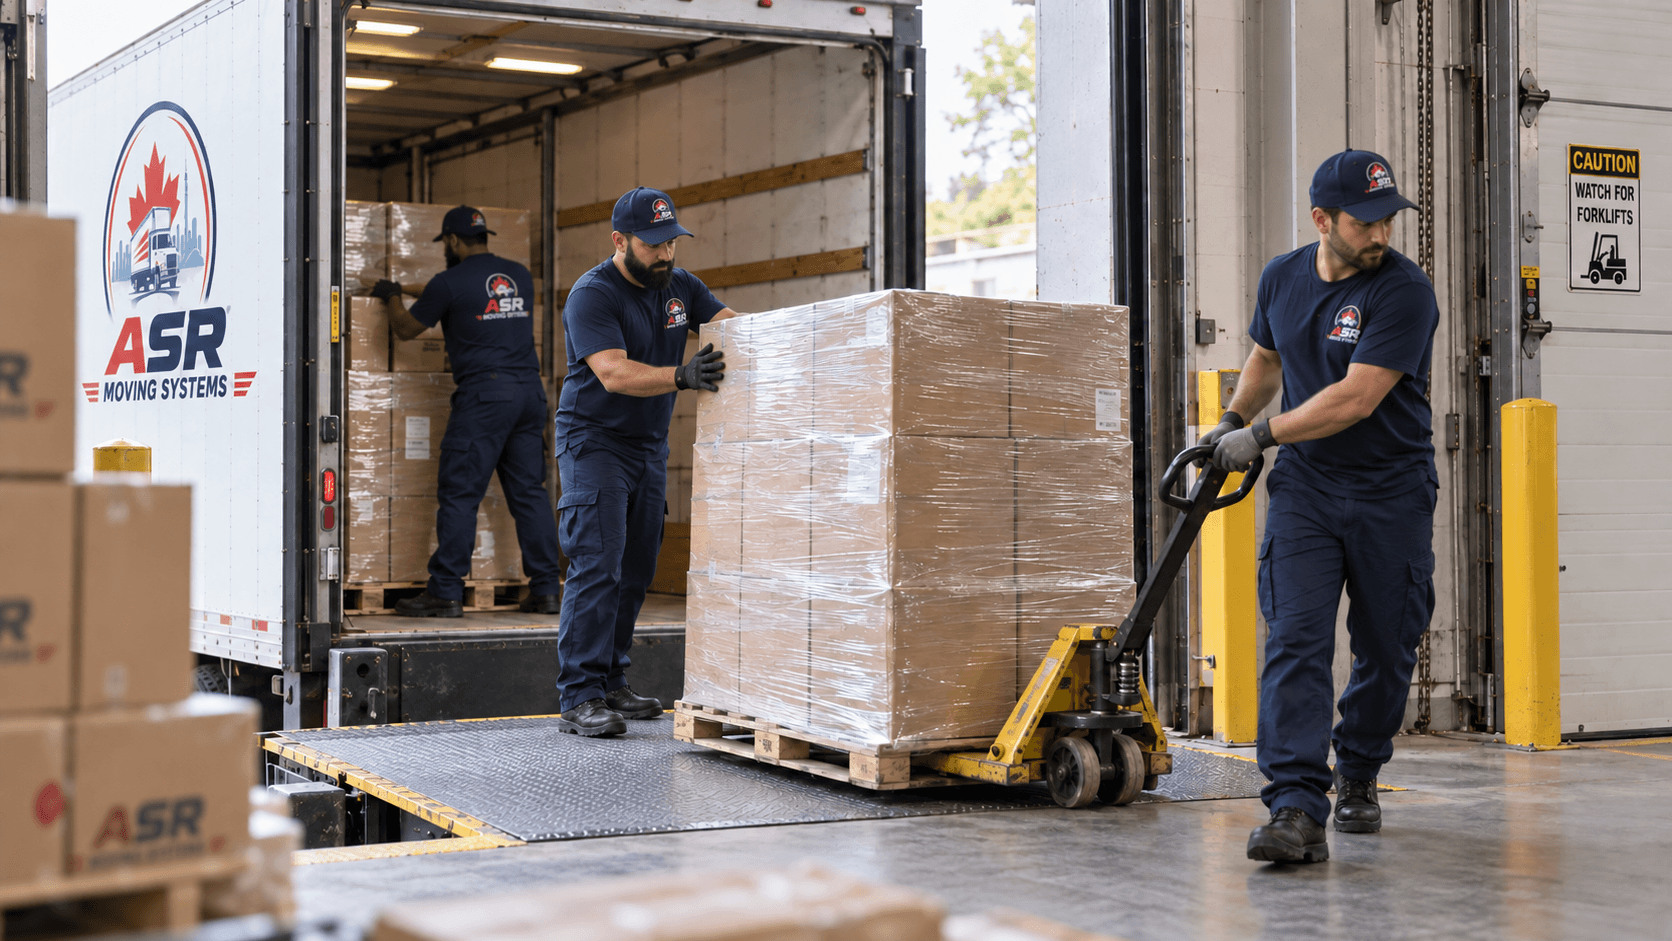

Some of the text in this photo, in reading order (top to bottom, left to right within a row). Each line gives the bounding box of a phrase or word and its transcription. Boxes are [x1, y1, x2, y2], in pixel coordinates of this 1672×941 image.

[1573, 151, 1636, 174] CAUTION
[1575, 182, 1635, 201] WATCH FOR
[1577, 206, 1634, 225] FORKLIFTS
[484, 297, 524, 314] ASR
[104, 306, 227, 376] ASR
[1331, 326, 1361, 339] ASR
[103, 374, 228, 403] MOVING SYSTEMS
[94, 795, 206, 850] ASR
